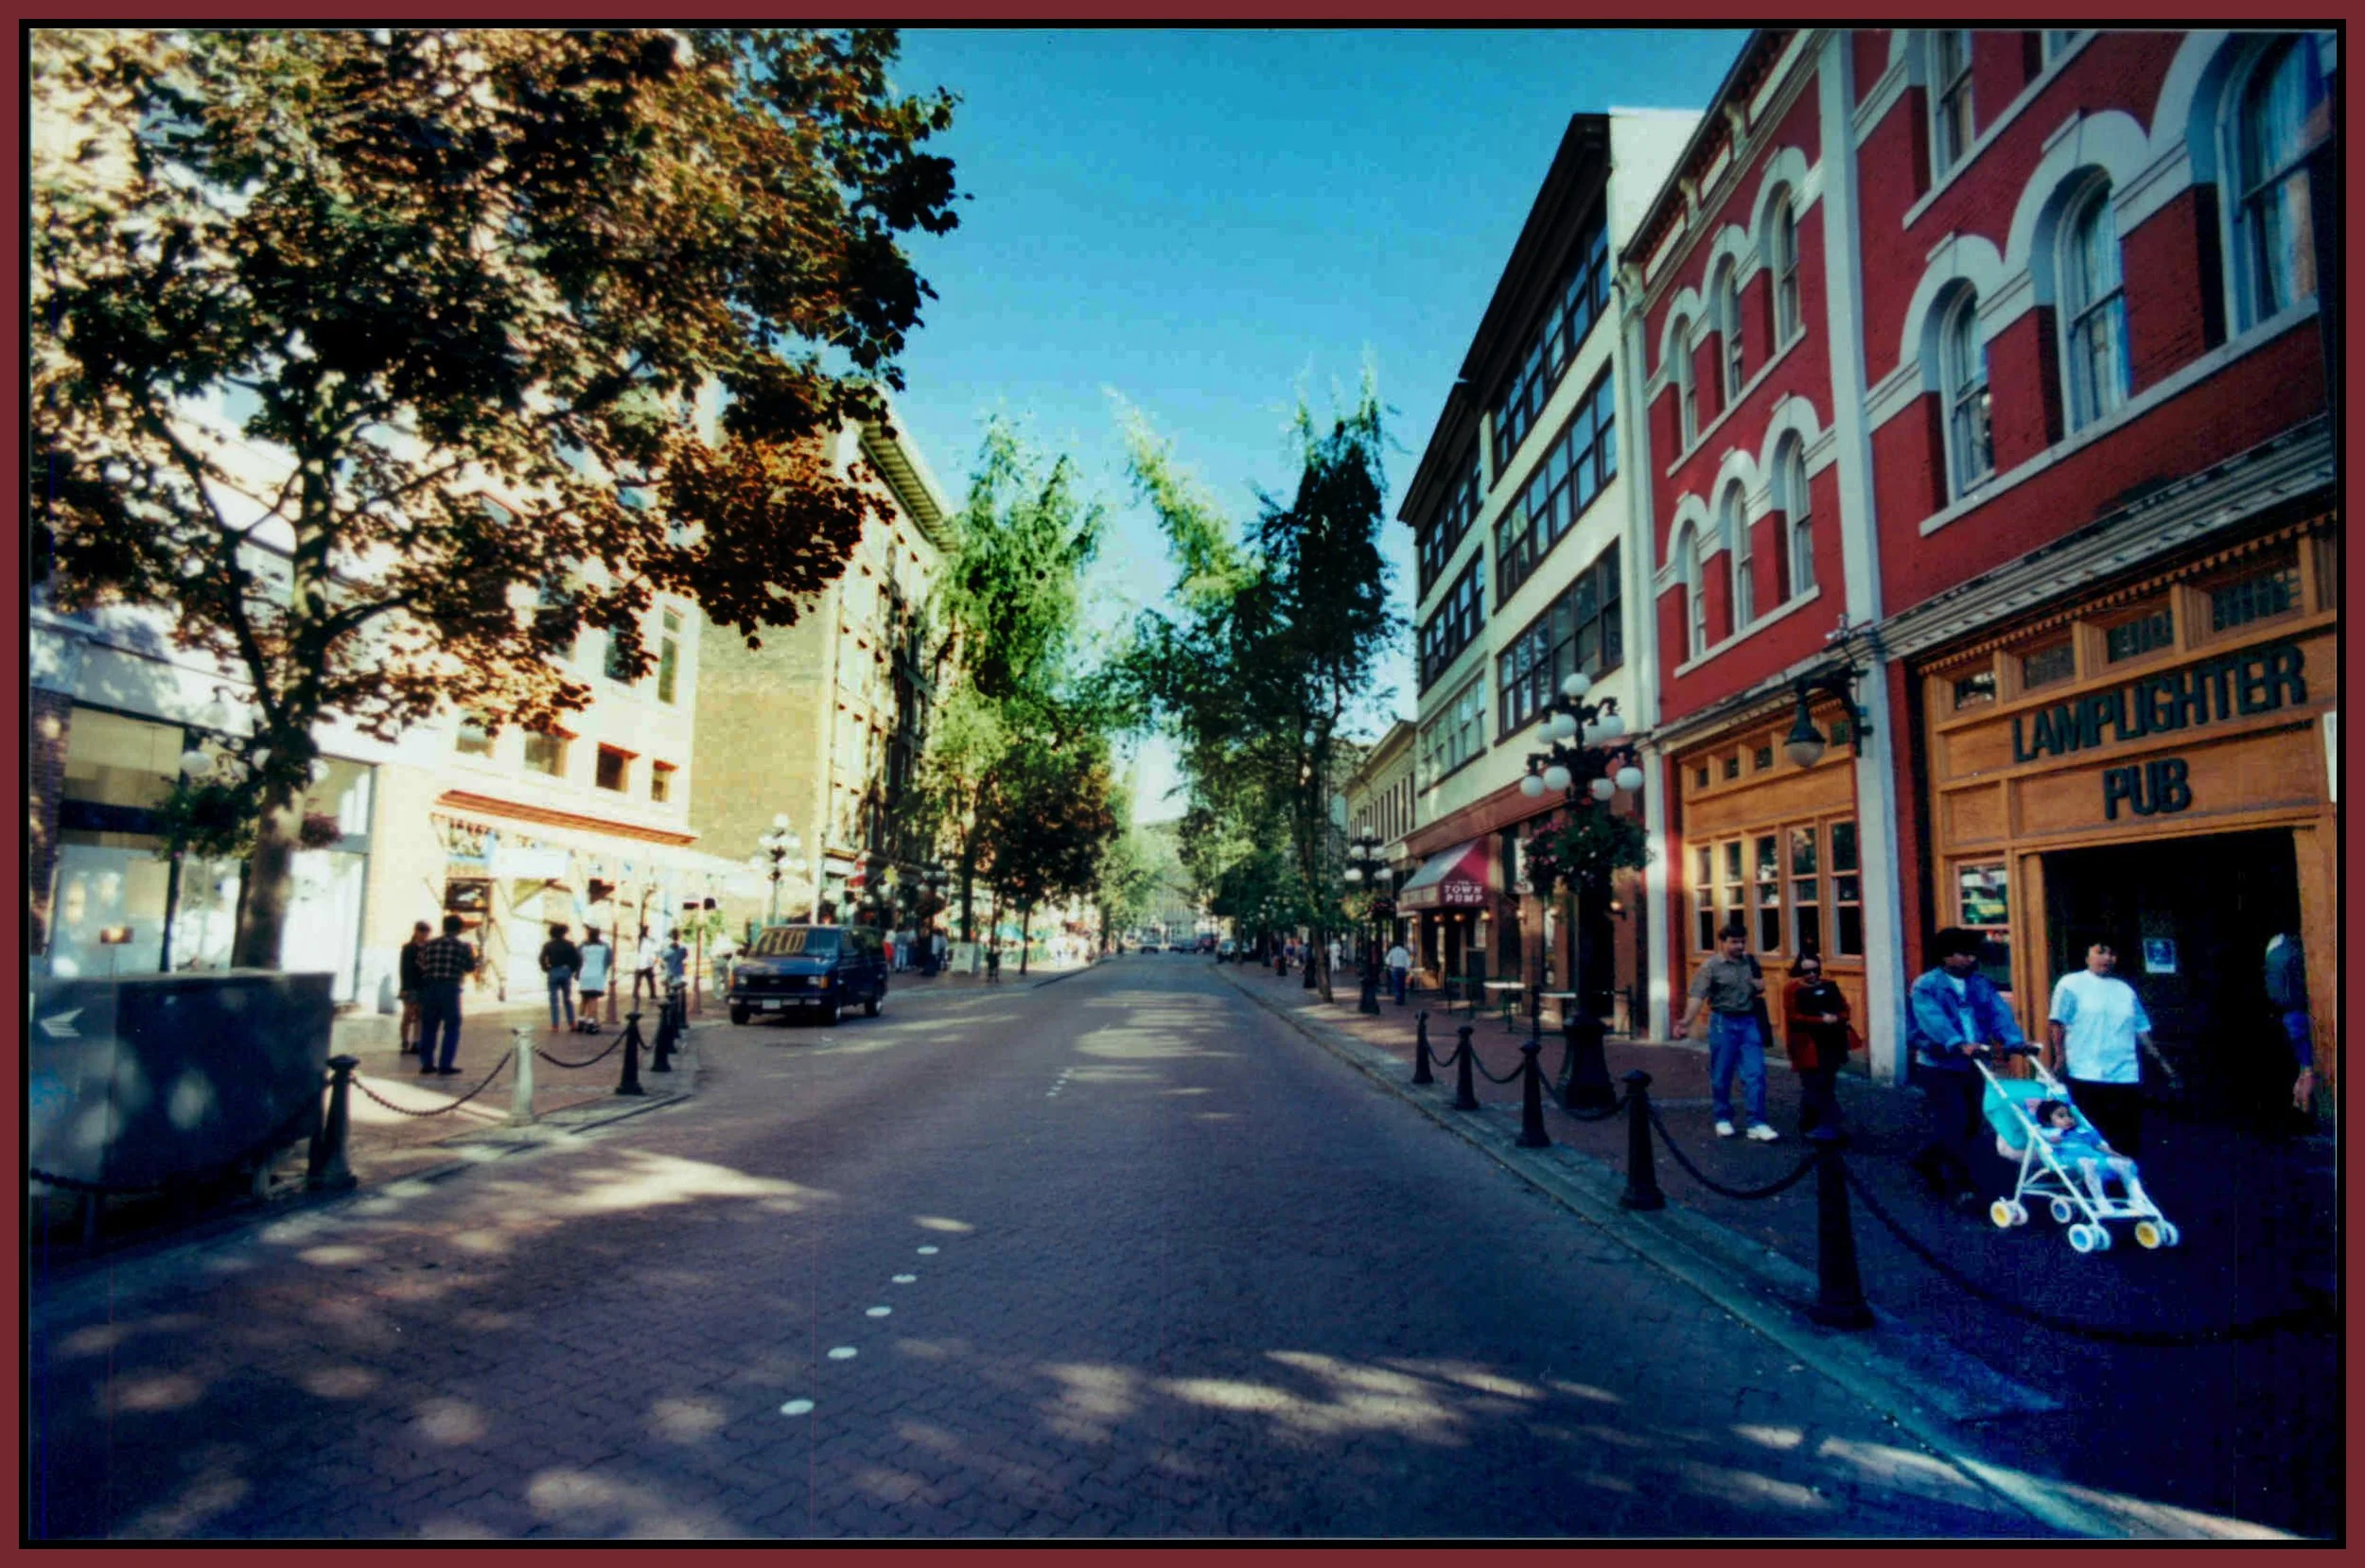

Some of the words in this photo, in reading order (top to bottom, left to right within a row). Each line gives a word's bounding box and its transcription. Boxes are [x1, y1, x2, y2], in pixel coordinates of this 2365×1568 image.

[2013, 643, 2307, 763] LAMPLIGHTER
[2103, 758, 2193, 820] PUB
[1444, 884, 1482, 894] TOWN
[1445, 894, 1483, 902] PUMP
